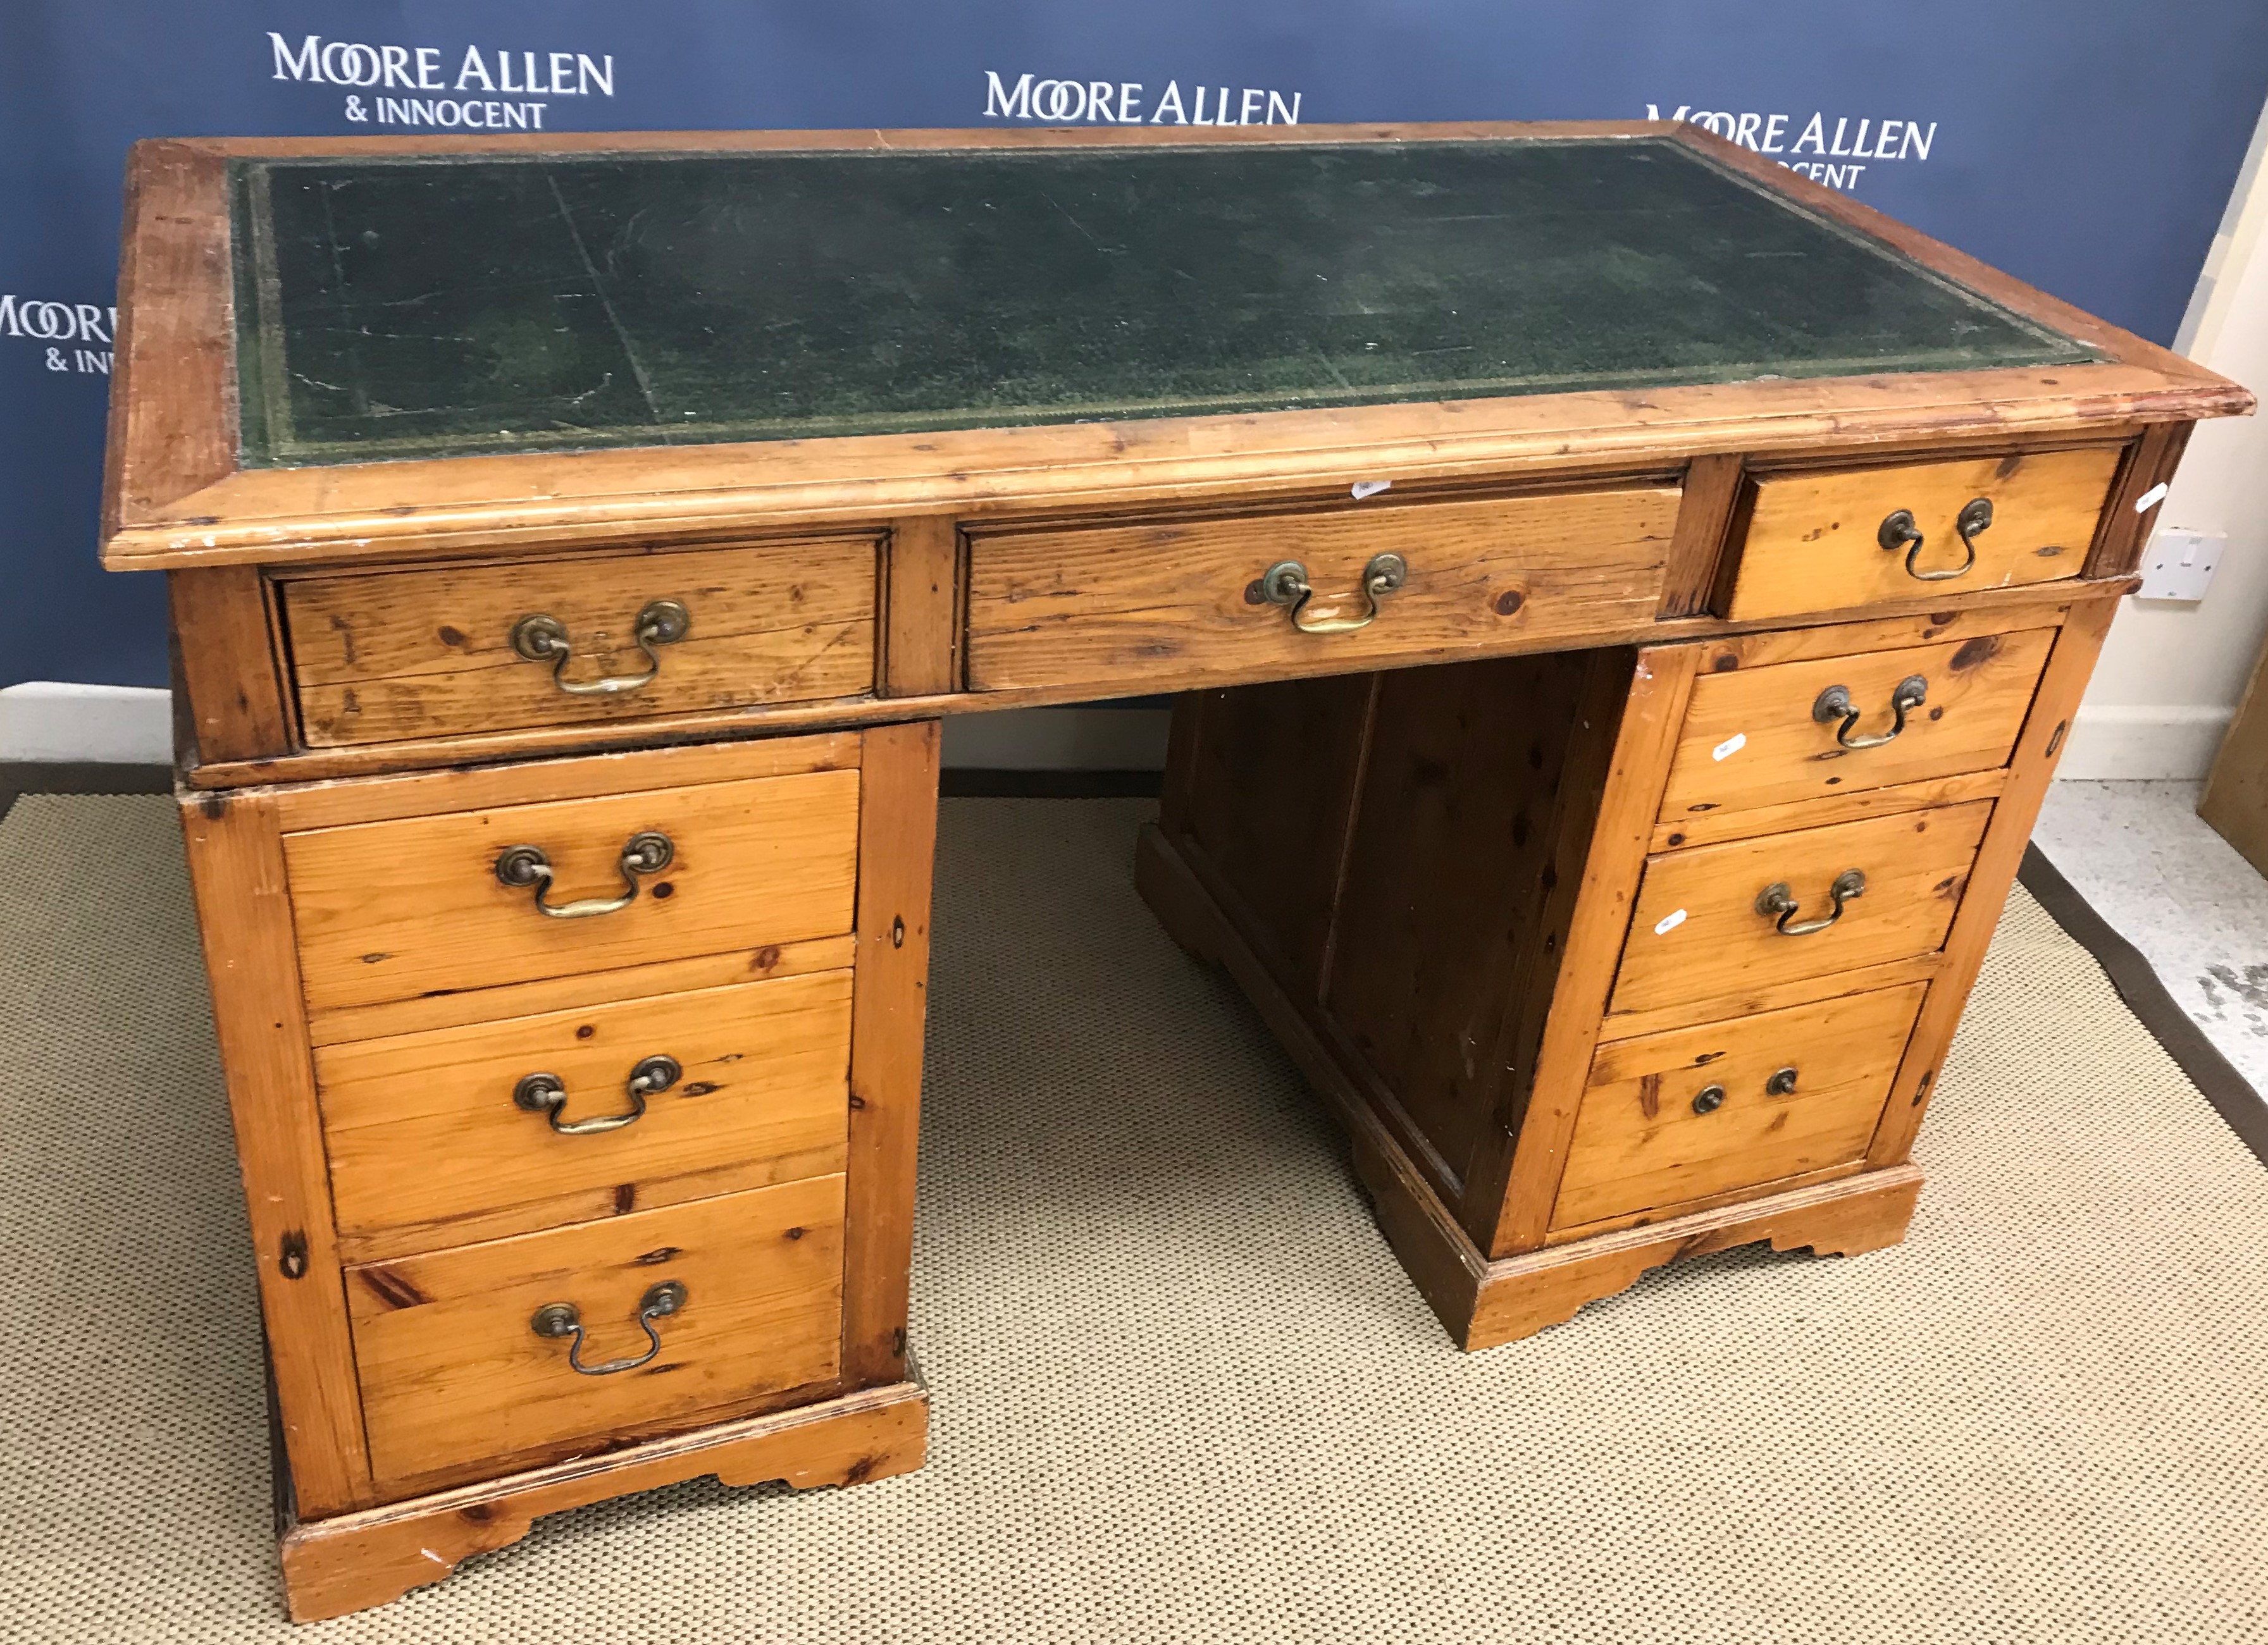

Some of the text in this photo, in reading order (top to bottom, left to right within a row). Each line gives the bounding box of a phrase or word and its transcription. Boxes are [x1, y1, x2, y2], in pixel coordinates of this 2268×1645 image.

[266, 32, 615, 96] MOORE ALLEN
[345, 94, 548, 128] & INNOCENT
[983, 70, 1302, 126] MOORE ALLEN
[1790, 111, 1937, 161] ALLEN
[45, 347, 69, 371] &
